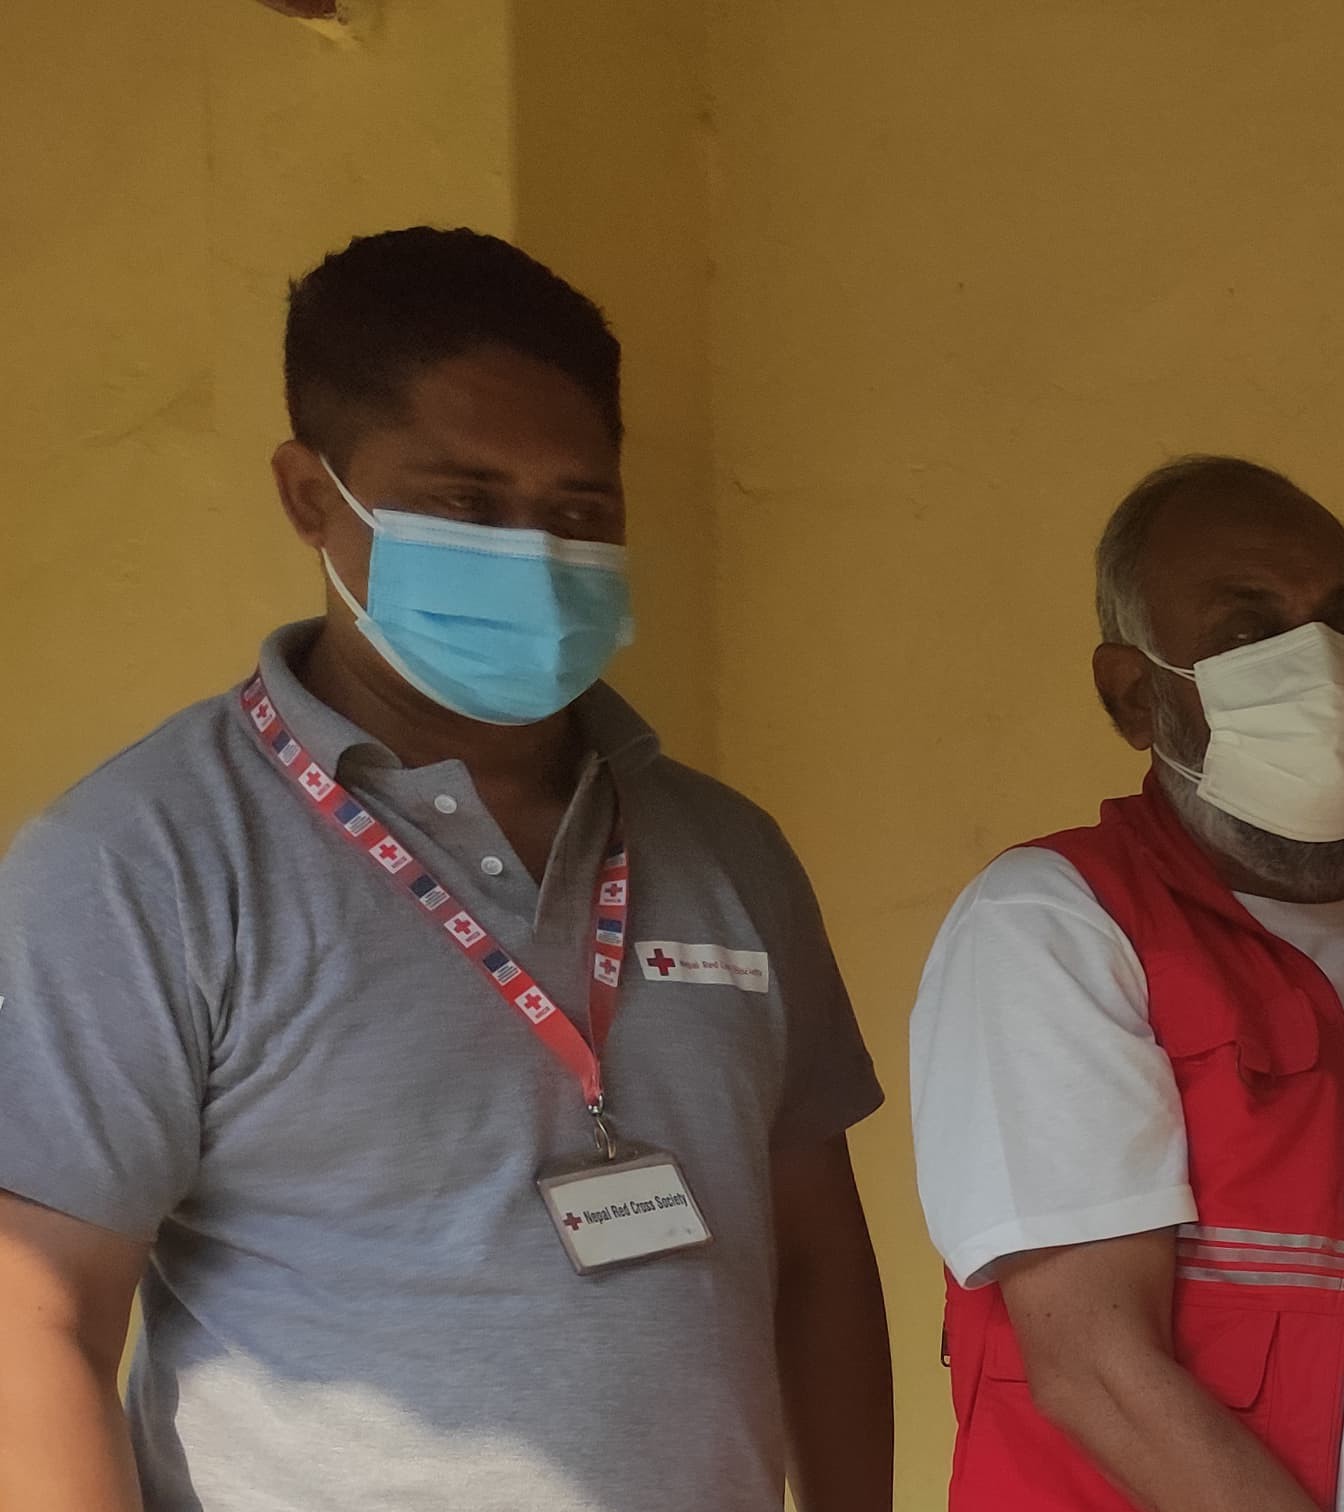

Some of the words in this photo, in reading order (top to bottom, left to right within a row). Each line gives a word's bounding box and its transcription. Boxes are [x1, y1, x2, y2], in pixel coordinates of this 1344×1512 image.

[583, 1206, 613, 1225] Nepal
[610, 1202, 631, 1218] Red
[629, 1198, 657, 1215] Cross
[654, 1192, 689, 1208] Society
